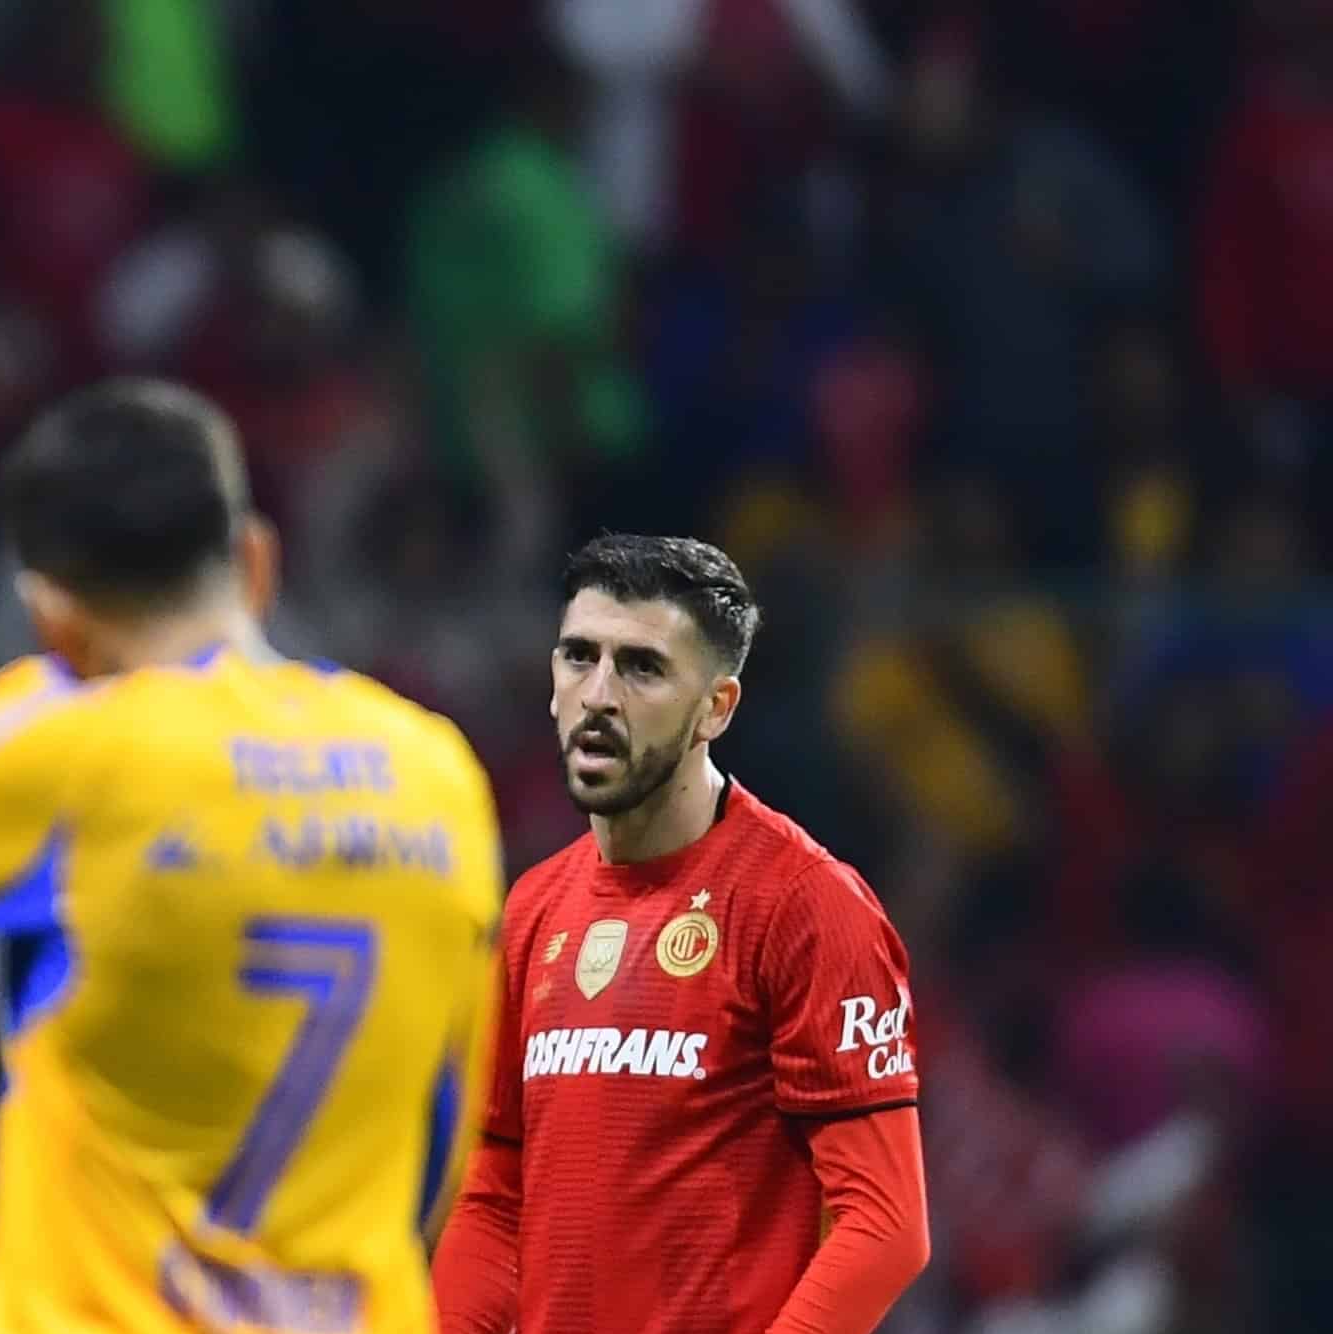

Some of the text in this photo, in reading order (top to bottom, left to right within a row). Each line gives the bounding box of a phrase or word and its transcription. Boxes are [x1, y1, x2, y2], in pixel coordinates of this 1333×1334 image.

[836, 984, 910, 1053] Red
[205, 913, 381, 1236] 7
[523, 1027, 709, 1082] OSHFRANS
